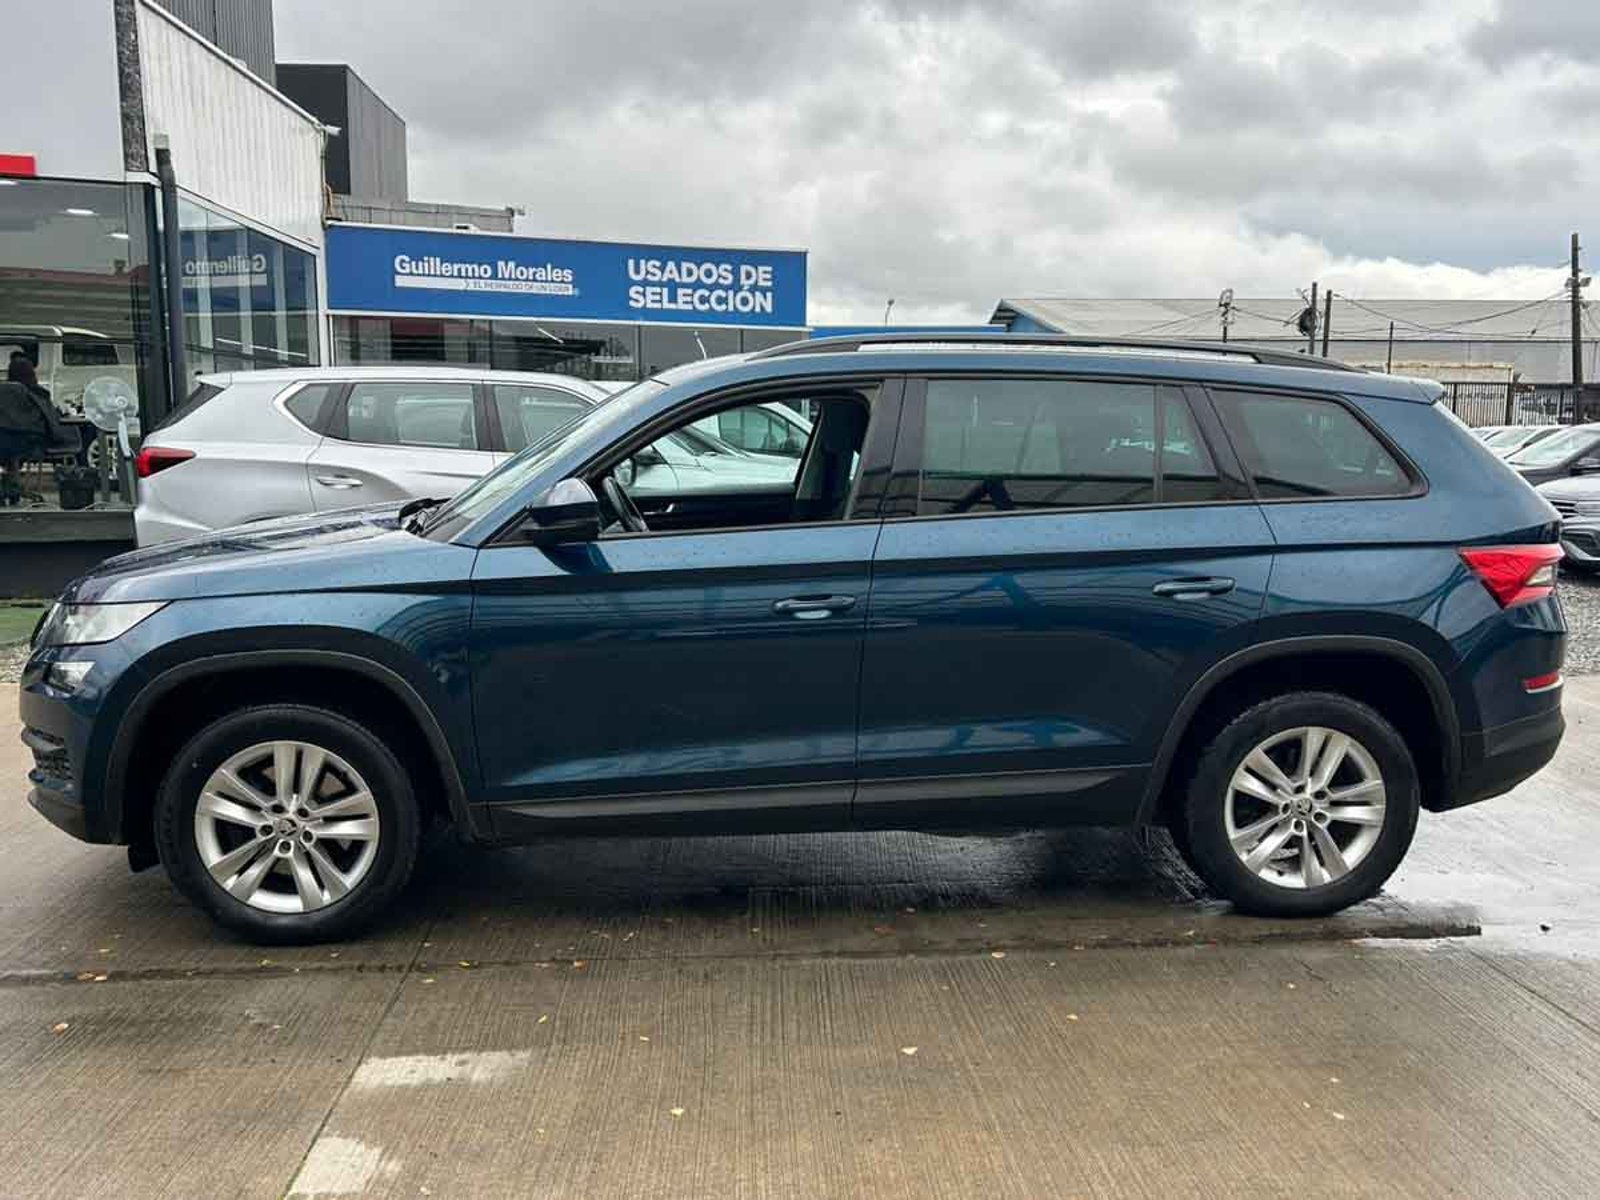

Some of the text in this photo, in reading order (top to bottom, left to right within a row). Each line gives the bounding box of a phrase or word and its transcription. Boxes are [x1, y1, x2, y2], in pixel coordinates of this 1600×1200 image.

[394, 254, 573, 282] Guillermo Morales
[627, 258, 773, 287] USADOS DE
[628, 284, 773, 313] SELECCIÓN
